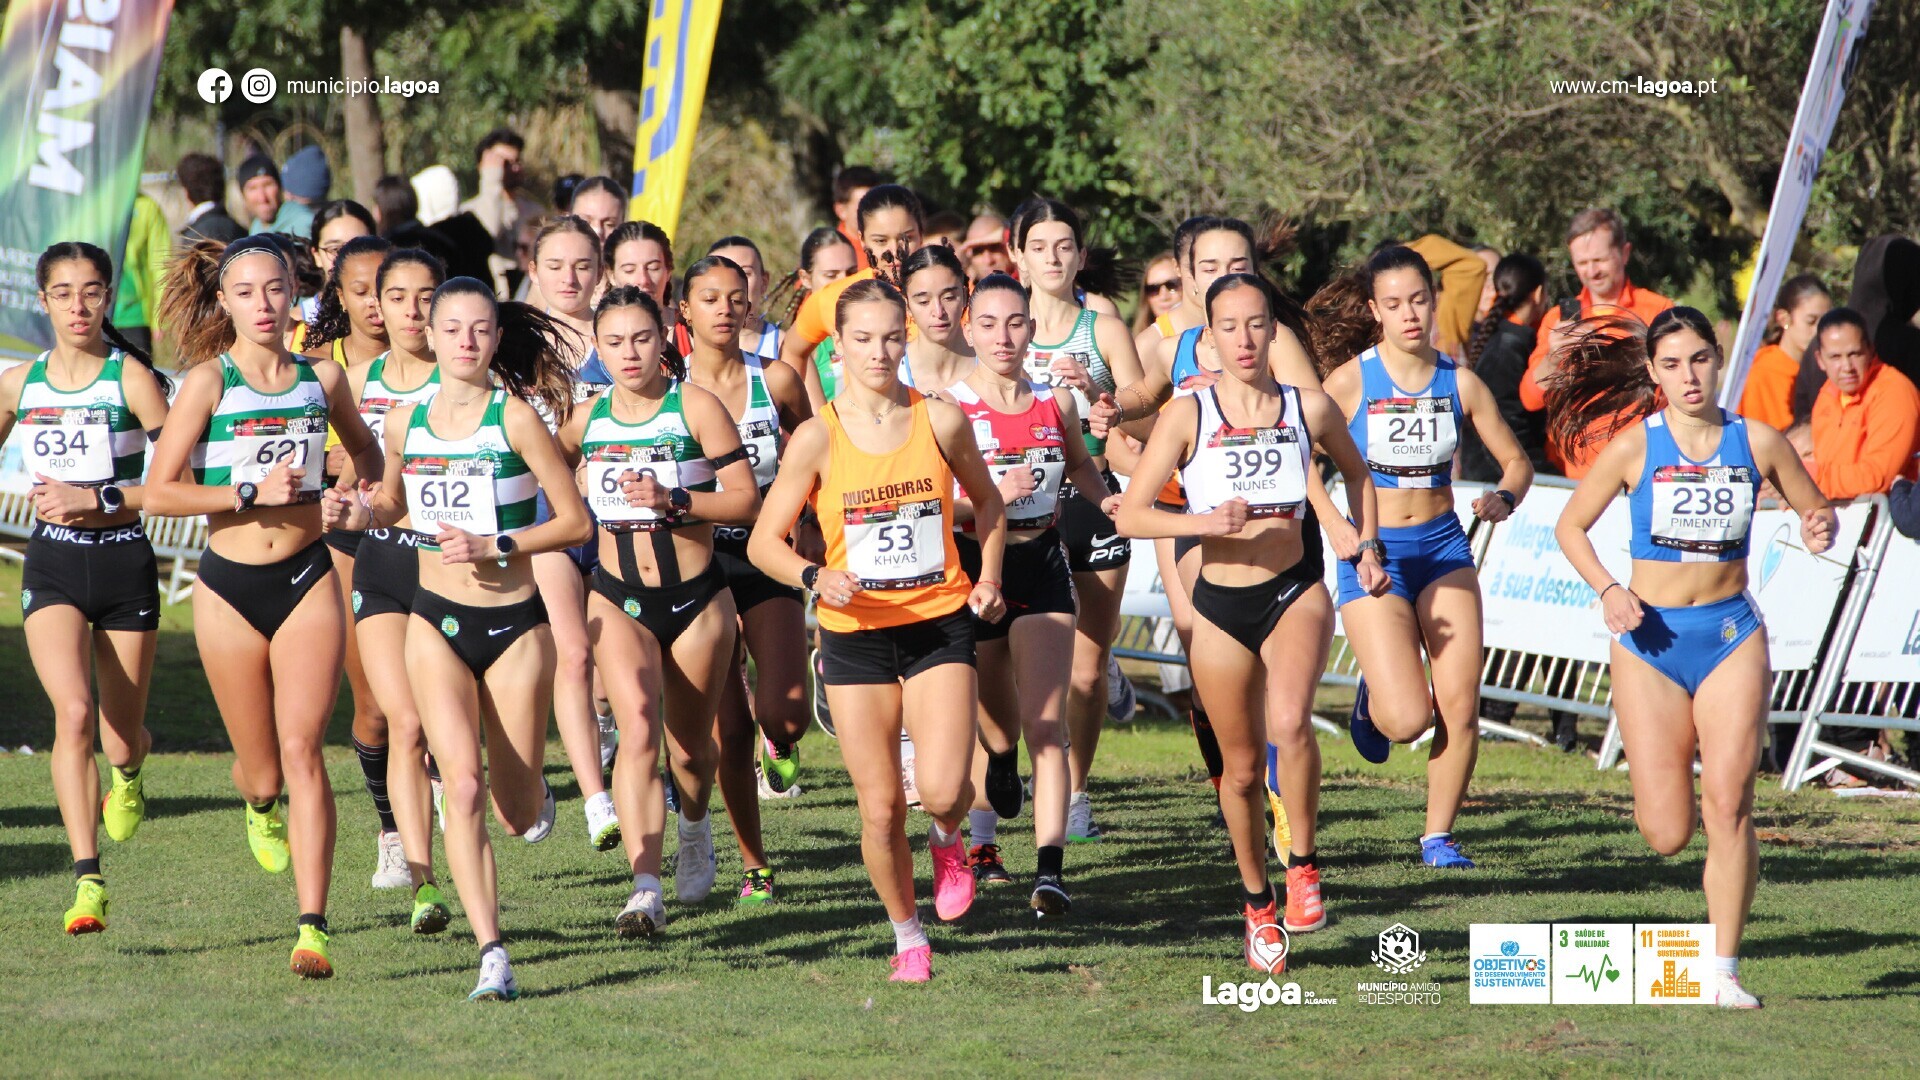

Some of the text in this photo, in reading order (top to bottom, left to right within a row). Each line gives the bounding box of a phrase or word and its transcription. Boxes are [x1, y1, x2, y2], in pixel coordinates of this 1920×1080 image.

[287, 418, 312, 428] CORTA
[285, 426, 308, 435] MATO
[1256, 429, 1281, 438] CORTA
[1388, 417, 1437, 442] 241
[34, 430, 89, 457] 634
[1254, 437, 1277, 445] MATO
[257, 438, 309, 465] 621
[631, 448, 657, 457] CORTA
[1025, 448, 1050, 458] CORTA
[1392, 445, 1432, 454] GOMES
[49, 458, 76, 468] RIJO
[629, 455, 652, 463] MATO
[1023, 456, 1046, 464] MATO
[1225, 449, 1282, 479] 399
[448, 461, 475, 469] CORTA
[446, 468, 469, 476] MATO
[1708, 468, 1734, 476] CORTA
[1233, 479, 1276, 491] NUNES
[1706, 476, 1730, 484] MATO
[421, 480, 471, 508] 612
[842, 478, 933, 507] NUCLEOEIRAS
[596, 495, 627, 507] FERN
[1672, 487, 1735, 515] 238
[898, 502, 926, 514] CORTA
[421, 510, 474, 521] CORREIA
[896, 511, 920, 521] MATO
[1670, 518, 1732, 528] PIMENTEL
[41, 524, 144, 544] NIKE PRO
[714, 527, 749, 540] RO
[878, 524, 914, 552] 53
[1506, 512, 1560, 559] Mergu
[874, 552, 918, 566] KHVAS
[1503, 571, 1533, 600] sua
